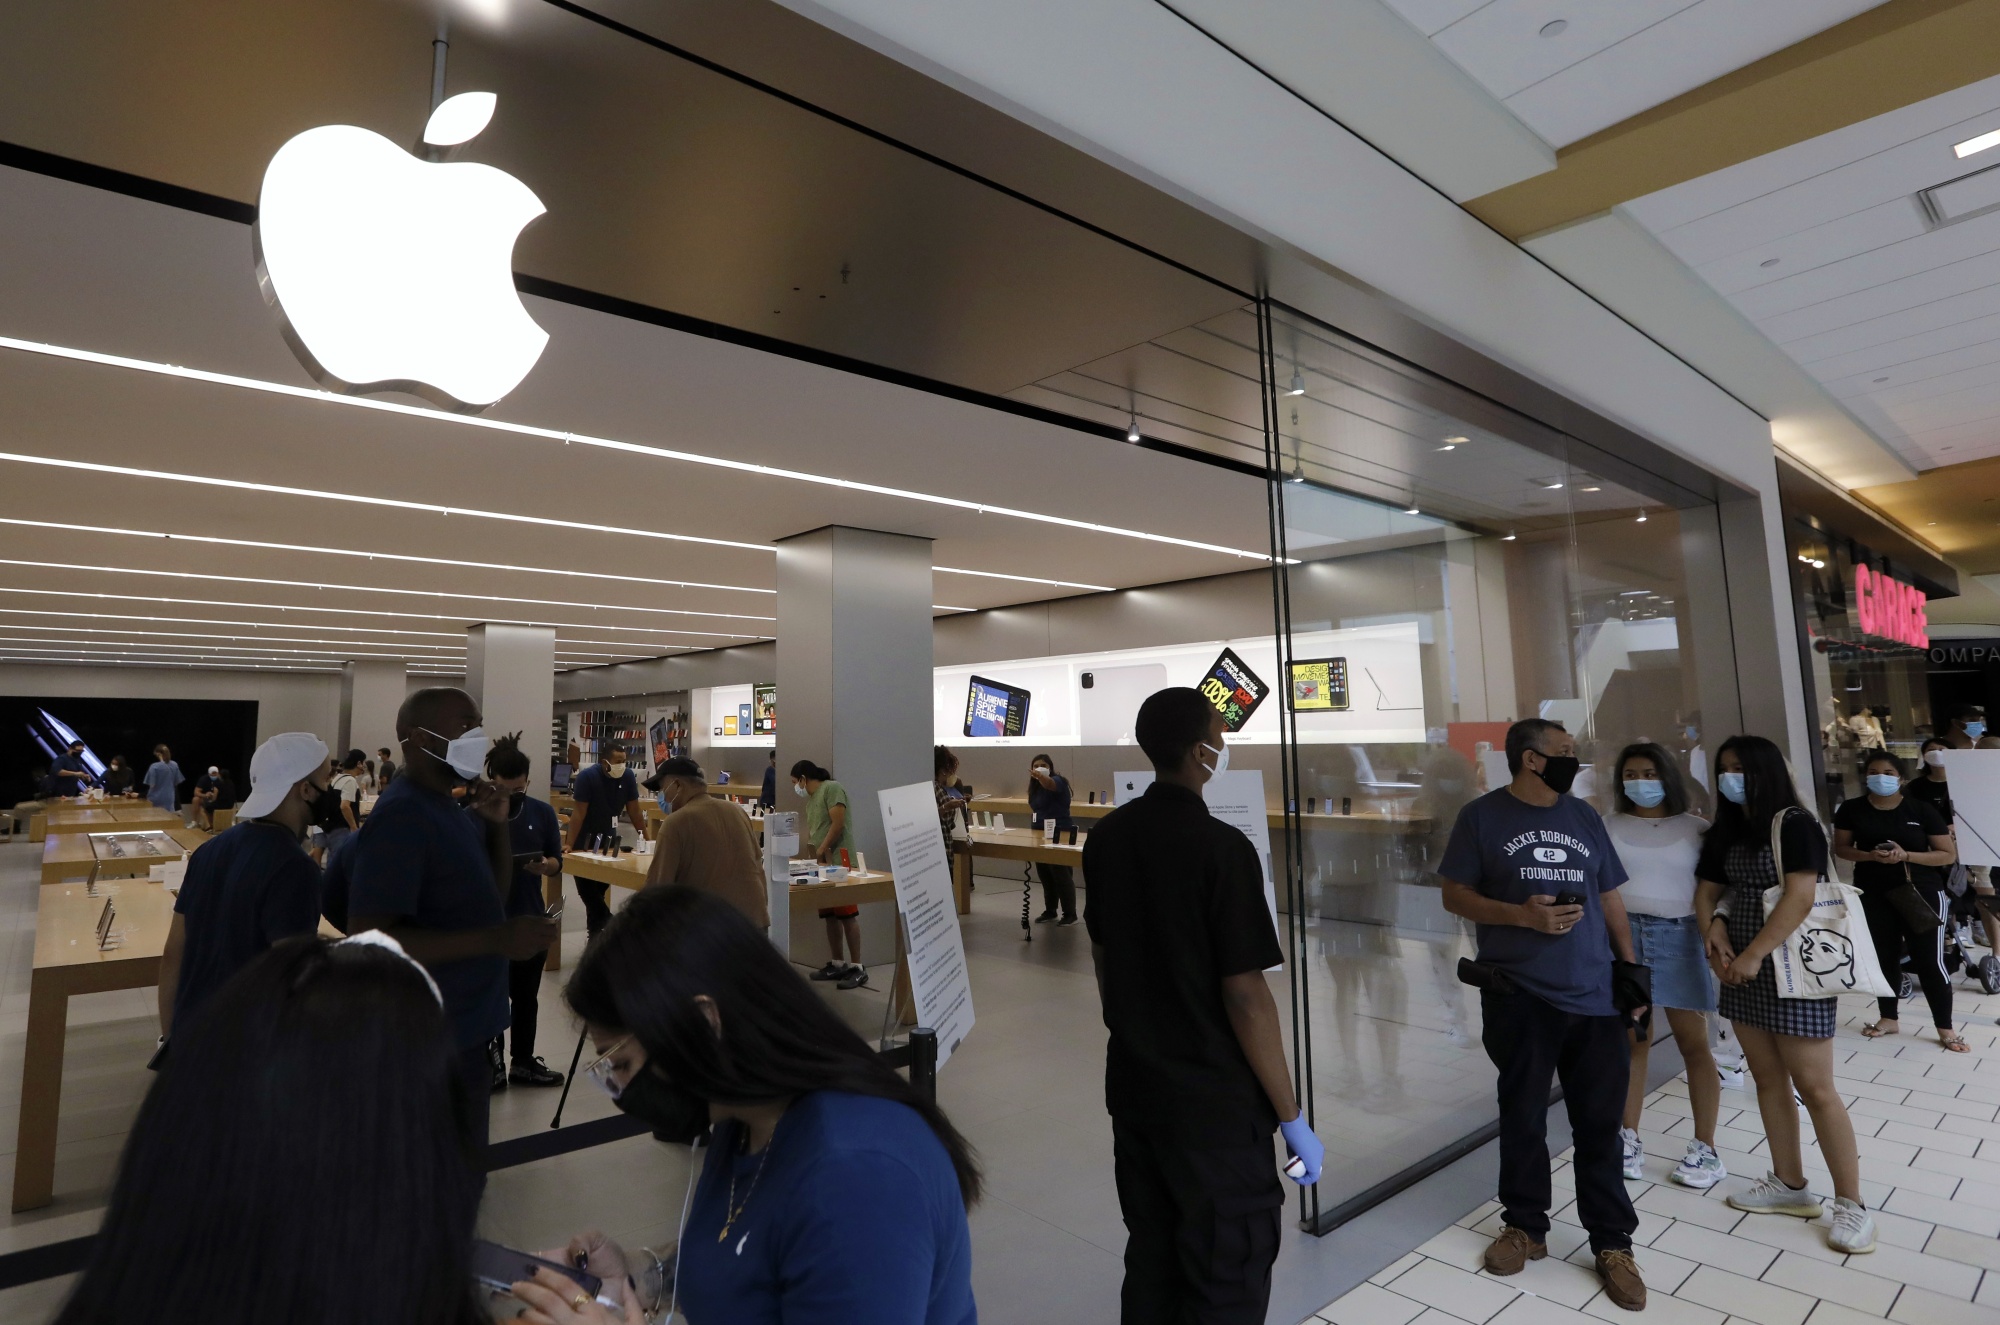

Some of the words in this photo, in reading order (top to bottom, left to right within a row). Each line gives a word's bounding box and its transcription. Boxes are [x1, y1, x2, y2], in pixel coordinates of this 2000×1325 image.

[1856, 563, 1929, 649] GARAGE
[1930, 647, 2000, 663] OMPA
[1304, 664, 1329, 673] DESIG
[1318, 679, 1330, 687] WA
[1319, 693, 1331, 701] TE
[1503, 831, 1539, 856] JACKIE
[1539, 830, 1590, 858] ROBINSON
[1543, 850, 1556, 861] 42
[1519, 867, 1584, 882] FOUNDATION
